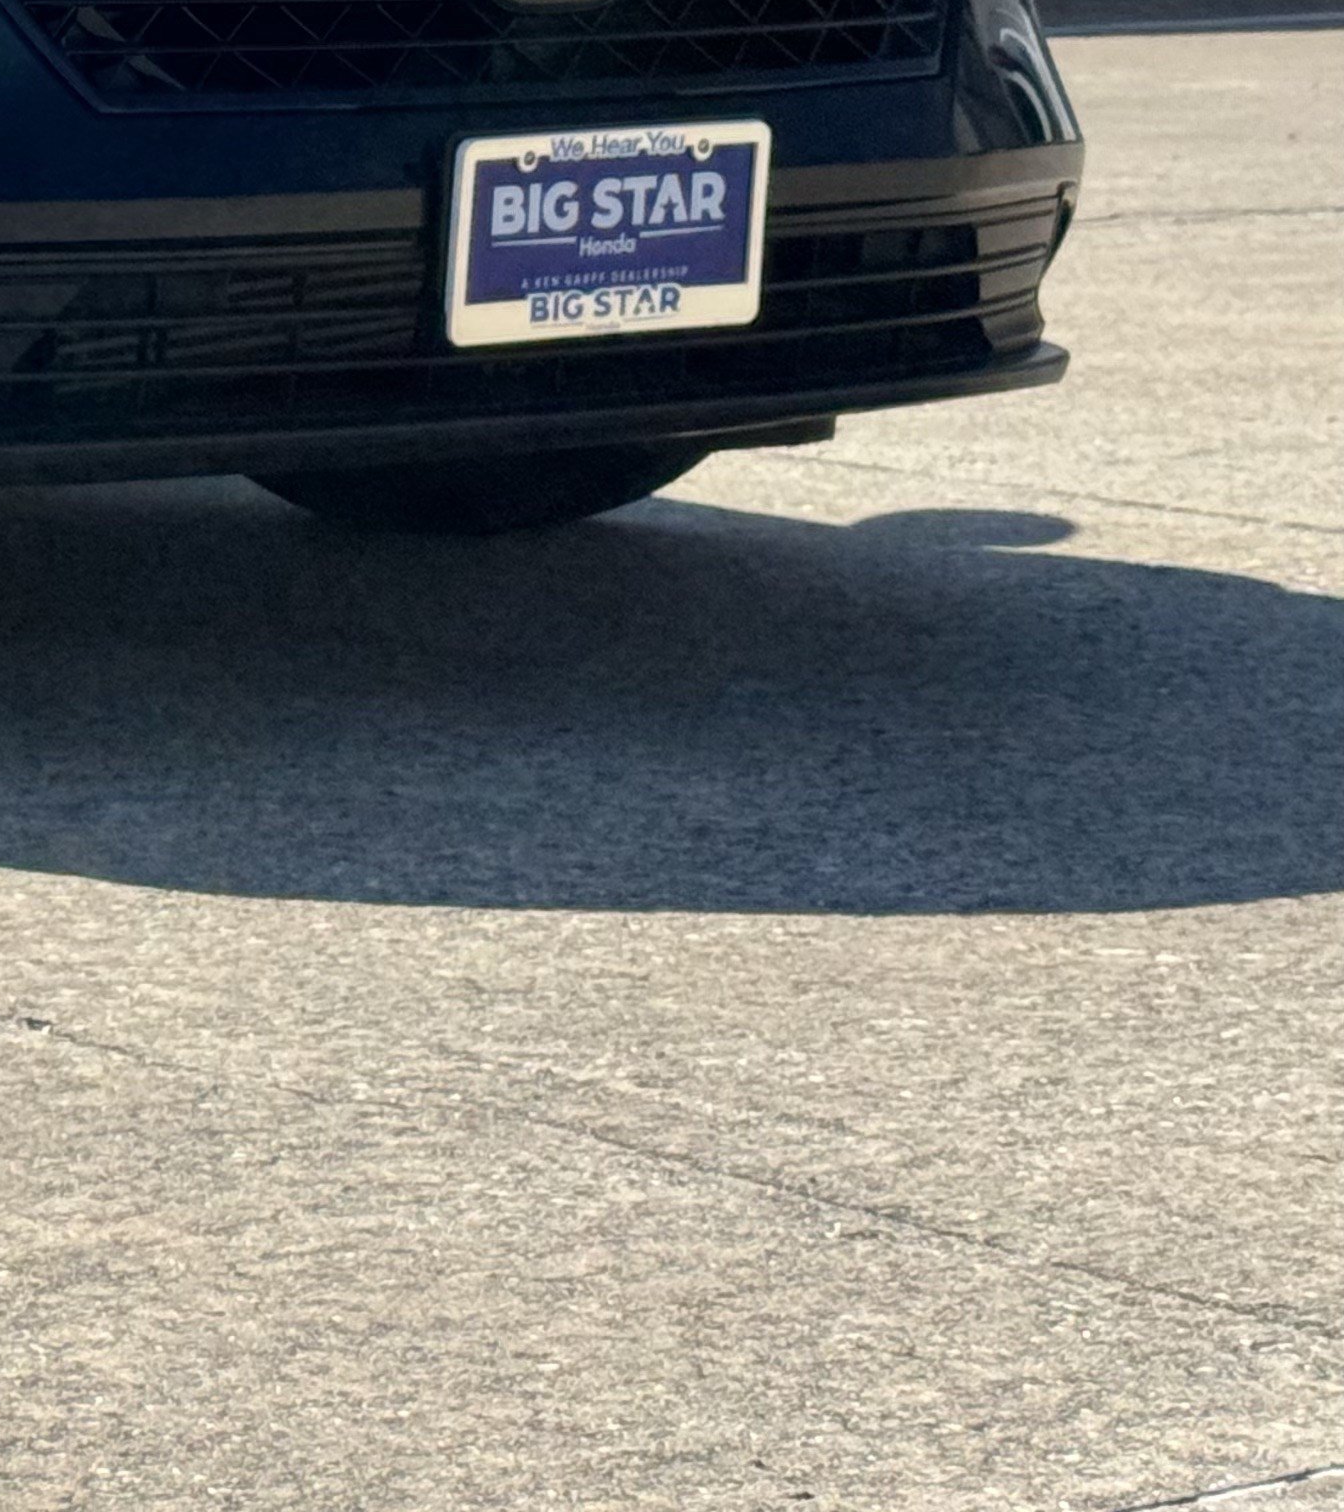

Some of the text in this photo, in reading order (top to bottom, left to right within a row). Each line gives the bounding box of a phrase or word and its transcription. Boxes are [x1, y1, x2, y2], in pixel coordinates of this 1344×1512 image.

[550, 131, 685, 158] We Hear You
[491, 171, 725, 236] BIG STAR
[579, 232, 637, 257] Honda
[530, 286, 680, 323] BIG STAR
